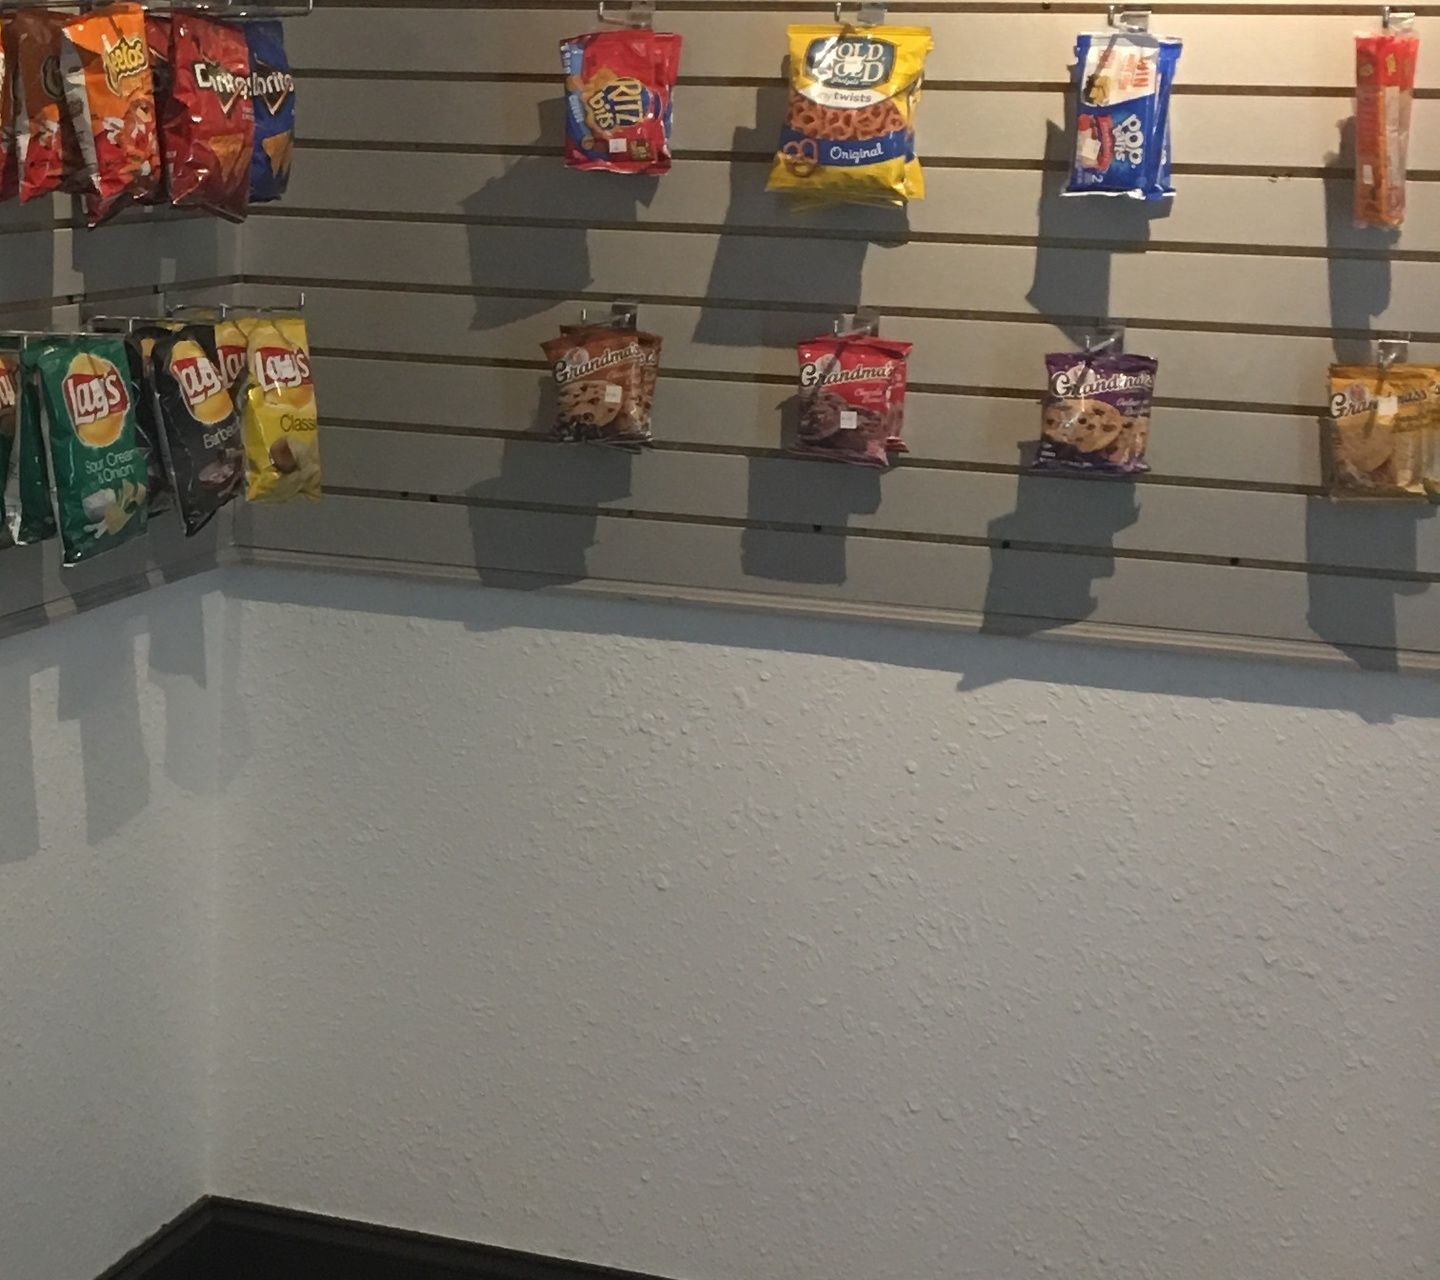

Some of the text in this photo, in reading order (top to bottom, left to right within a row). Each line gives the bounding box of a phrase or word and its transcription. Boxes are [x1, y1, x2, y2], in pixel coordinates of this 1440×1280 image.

[607, 78, 643, 126] RITZ
[833, 92, 872, 103] twists
[829, 142, 884, 164] Original
[255, 349, 310, 392] Lay's
[554, 341, 642, 384] Grandma's
[801, 360, 895, 388] Grandma's
[67, 372, 121, 426] Lay's
[1051, 371, 1154, 398] Grandma's
